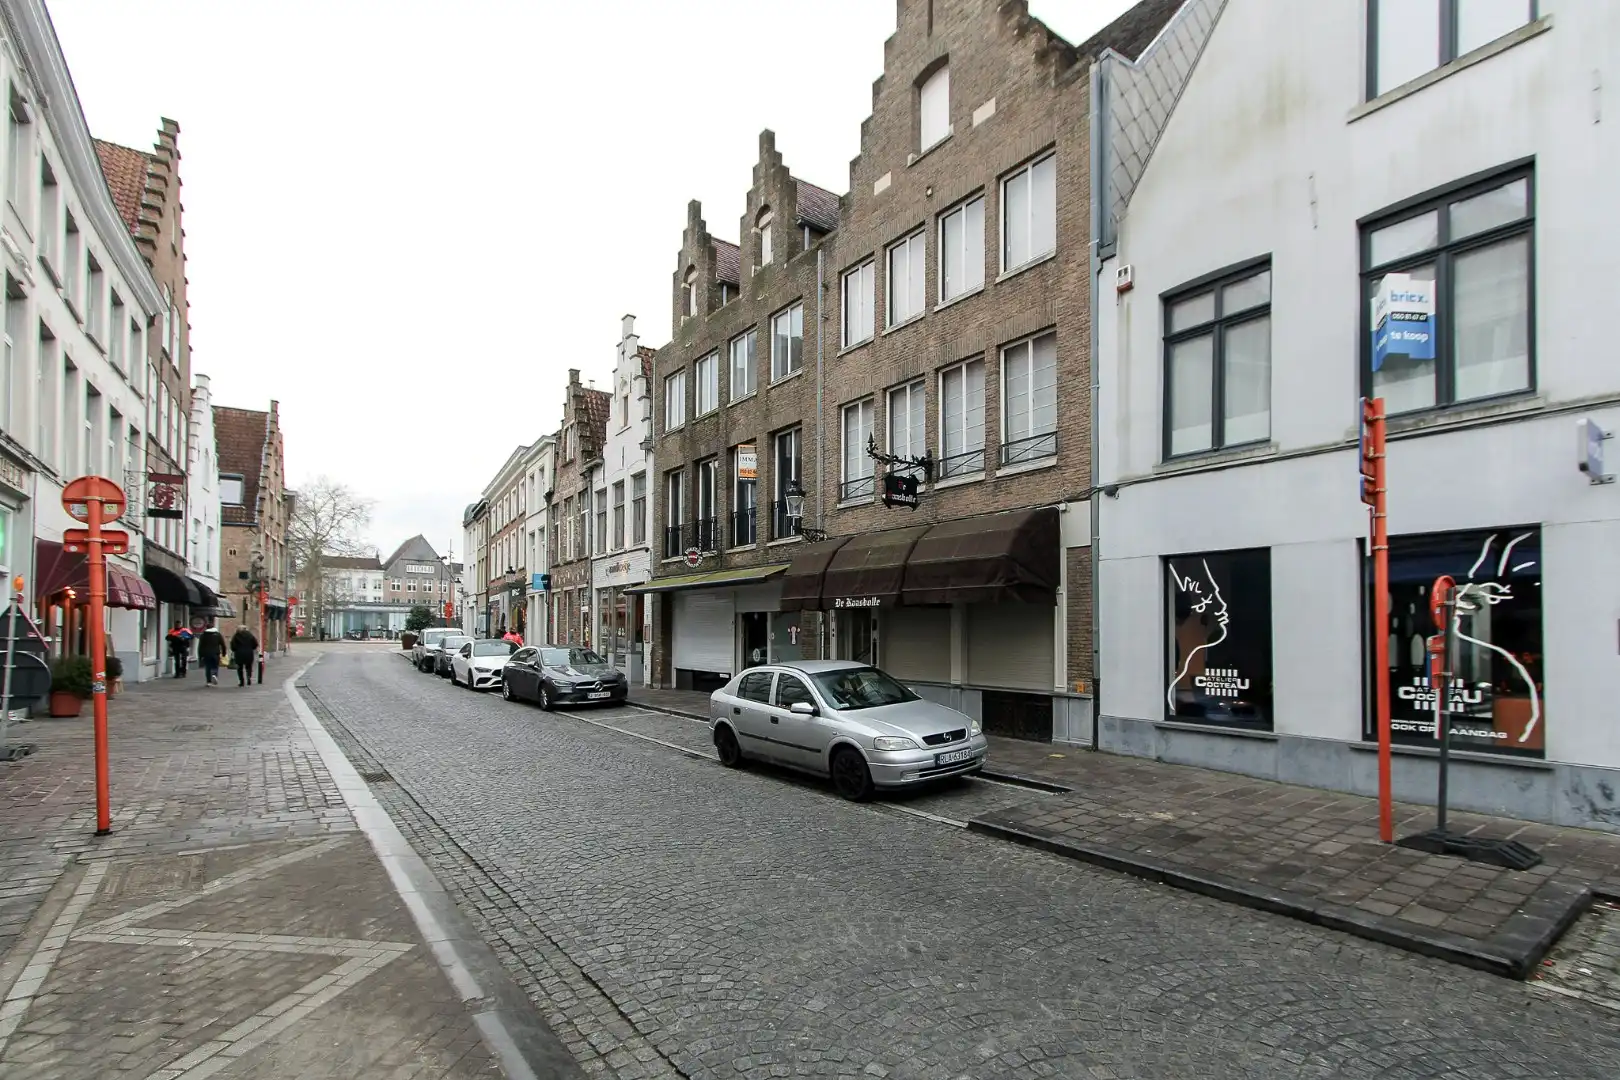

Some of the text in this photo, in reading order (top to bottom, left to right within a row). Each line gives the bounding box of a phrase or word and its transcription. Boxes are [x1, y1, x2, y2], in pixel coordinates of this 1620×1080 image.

[1390, 331, 1429, 343] te koop
[835, 598, 844, 607] De
[1195, 676, 1250, 689] COCTEAU
[1391, 723, 1416, 732] OOK
[1449, 728, 1507, 738] AANDAG
